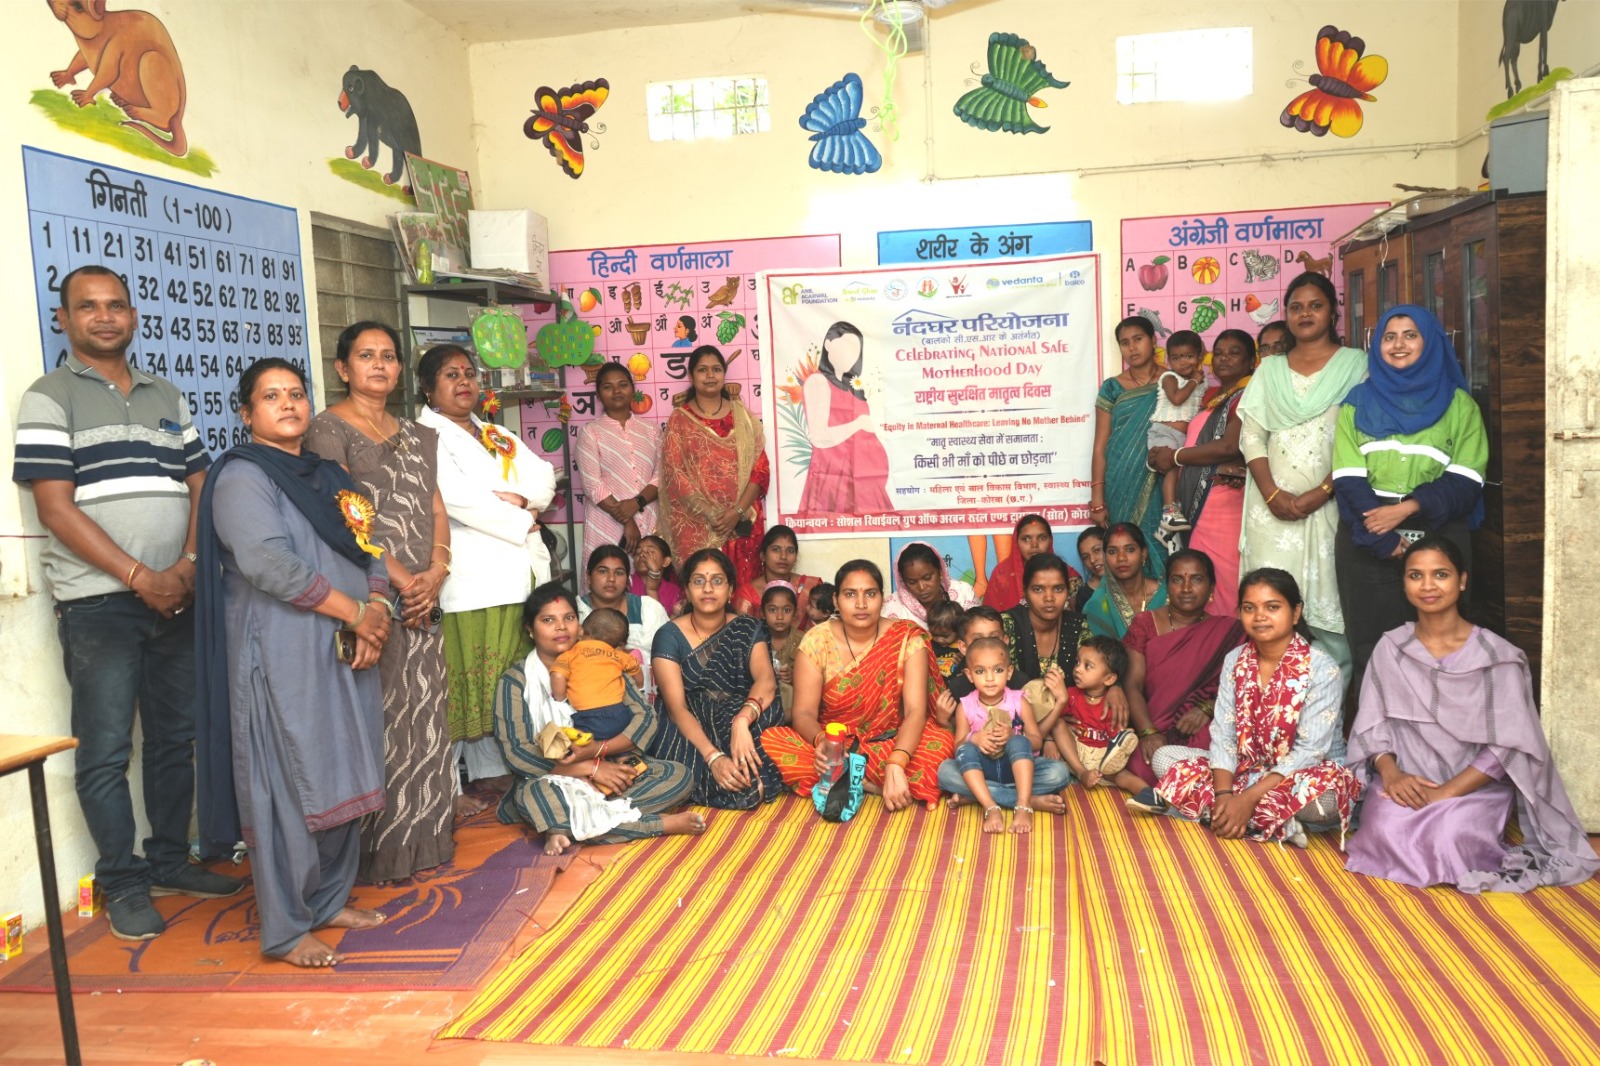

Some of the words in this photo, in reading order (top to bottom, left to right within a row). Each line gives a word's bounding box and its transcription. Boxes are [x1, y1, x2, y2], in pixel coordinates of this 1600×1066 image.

[85, 168, 147, 218] गिनती
[1169, 217, 1229, 247] अंग्रेजी
[1234, 215, 1325, 243] वर्णमाला
[43, 221, 51, 248] 1
[73, 226, 91, 254] 11
[104, 232, 123, 258] 21
[135, 236, 153, 262] 31
[164, 241, 181, 266] 41
[188, 245, 206, 269] 51
[216, 250, 231, 273] 61
[239, 253, 253, 275] 71
[262, 256, 275, 279] 81
[282, 260, 295, 281] 91
[916, 234, 958, 260] शरीर
[969, 231, 990, 257] के
[998, 231, 1033, 255] अंग
[587, 249, 638, 278] हिन्दी
[649, 246, 734, 271] वर्णमाला
[1126, 255, 1135, 272] A
[1178, 255, 1188, 270] B
[1229, 252, 1238, 266] C
[1284, 249, 1294, 264] D
[47, 265, 60, 292] 2
[138, 275, 159, 301] 32
[167, 279, 188, 304] 42
[193, 281, 213, 306] 52
[219, 285, 236, 308] 62
[242, 287, 258, 310] 72
[264, 289, 280, 312] 82
[285, 292, 300, 313] 92
[608, 286, 617, 300] इ
[654, 280, 664, 298] ई
[701, 281, 710, 293] उ
[1001, 276, 1043, 286] vedanta
[1064, 279, 1085, 287] balco
[802, 297, 838, 305] FOUNDATION
[1127, 303, 1135, 316] F
[1178, 301, 1187, 314] G
[1231, 298, 1240, 312] H
[141, 315, 163, 340] 33
[171, 317, 191, 341] 43
[197, 319, 215, 343] 53
[222, 321, 239, 344] 63
[245, 321, 261, 344] 73
[267, 323, 283, 346] 83
[288, 325, 302, 346] 93
[654, 314, 668, 332] औ
[701, 313, 712, 328] अं
[892, 317, 959, 336] नंदघर
[961, 311, 1070, 333] परियोजना
[999, 331, 1007, 341] के
[146, 353, 168, 377] 34
[175, 354, 194, 378] 44
[200, 355, 219, 378] 54
[226, 356, 243, 378] 64
[204, 391, 222, 415] 55
[659, 388, 670, 401] ठ
[914, 386, 945, 405] राष्ट्रीय
[947, 385, 986, 405] सुरक्षित
[988, 385, 1020, 404] मातृत्व
[1023, 382, 1052, 398] दिवस
[527, 427, 538, 440] त
[570, 425, 578, 437] थ
[916, 420, 948, 430] Maternal
[949, 419, 991, 428] Healthcare:
[992, 418, 1020, 428] Leaving
[1021, 417, 1032, 425] No
[1033, 415, 1059, 425] Mother
[207, 427, 227, 451] 56
[948, 435, 977, 446] स्वास्थ्य
[978, 433, 995, 445] सेवा
[995, 433, 1005, 444] में
[1005, 433, 1039, 444] समानता
[913, 453, 939, 469] किसी
[942, 453, 955, 469] भी
[957, 451, 970, 467] माँ
[973, 453, 985, 467] को
[987, 452, 1006, 466] पीछे
[1009, 454, 1018, 465] न
[895, 485, 920, 495] सहयोग
[929, 484, 953, 494] महिला
[955, 482, 966, 493] एवं
[968, 483, 984, 492] बाल
[987, 481, 1011, 492] विकास
[1043, 480, 1070, 490] स्वास्थ्य
[836, 515, 862, 527] सोशल
[918, 512, 938, 525] ऑफ
[939, 512, 965, 524] अरबन
[990, 511, 1009, 522] एण्ड
